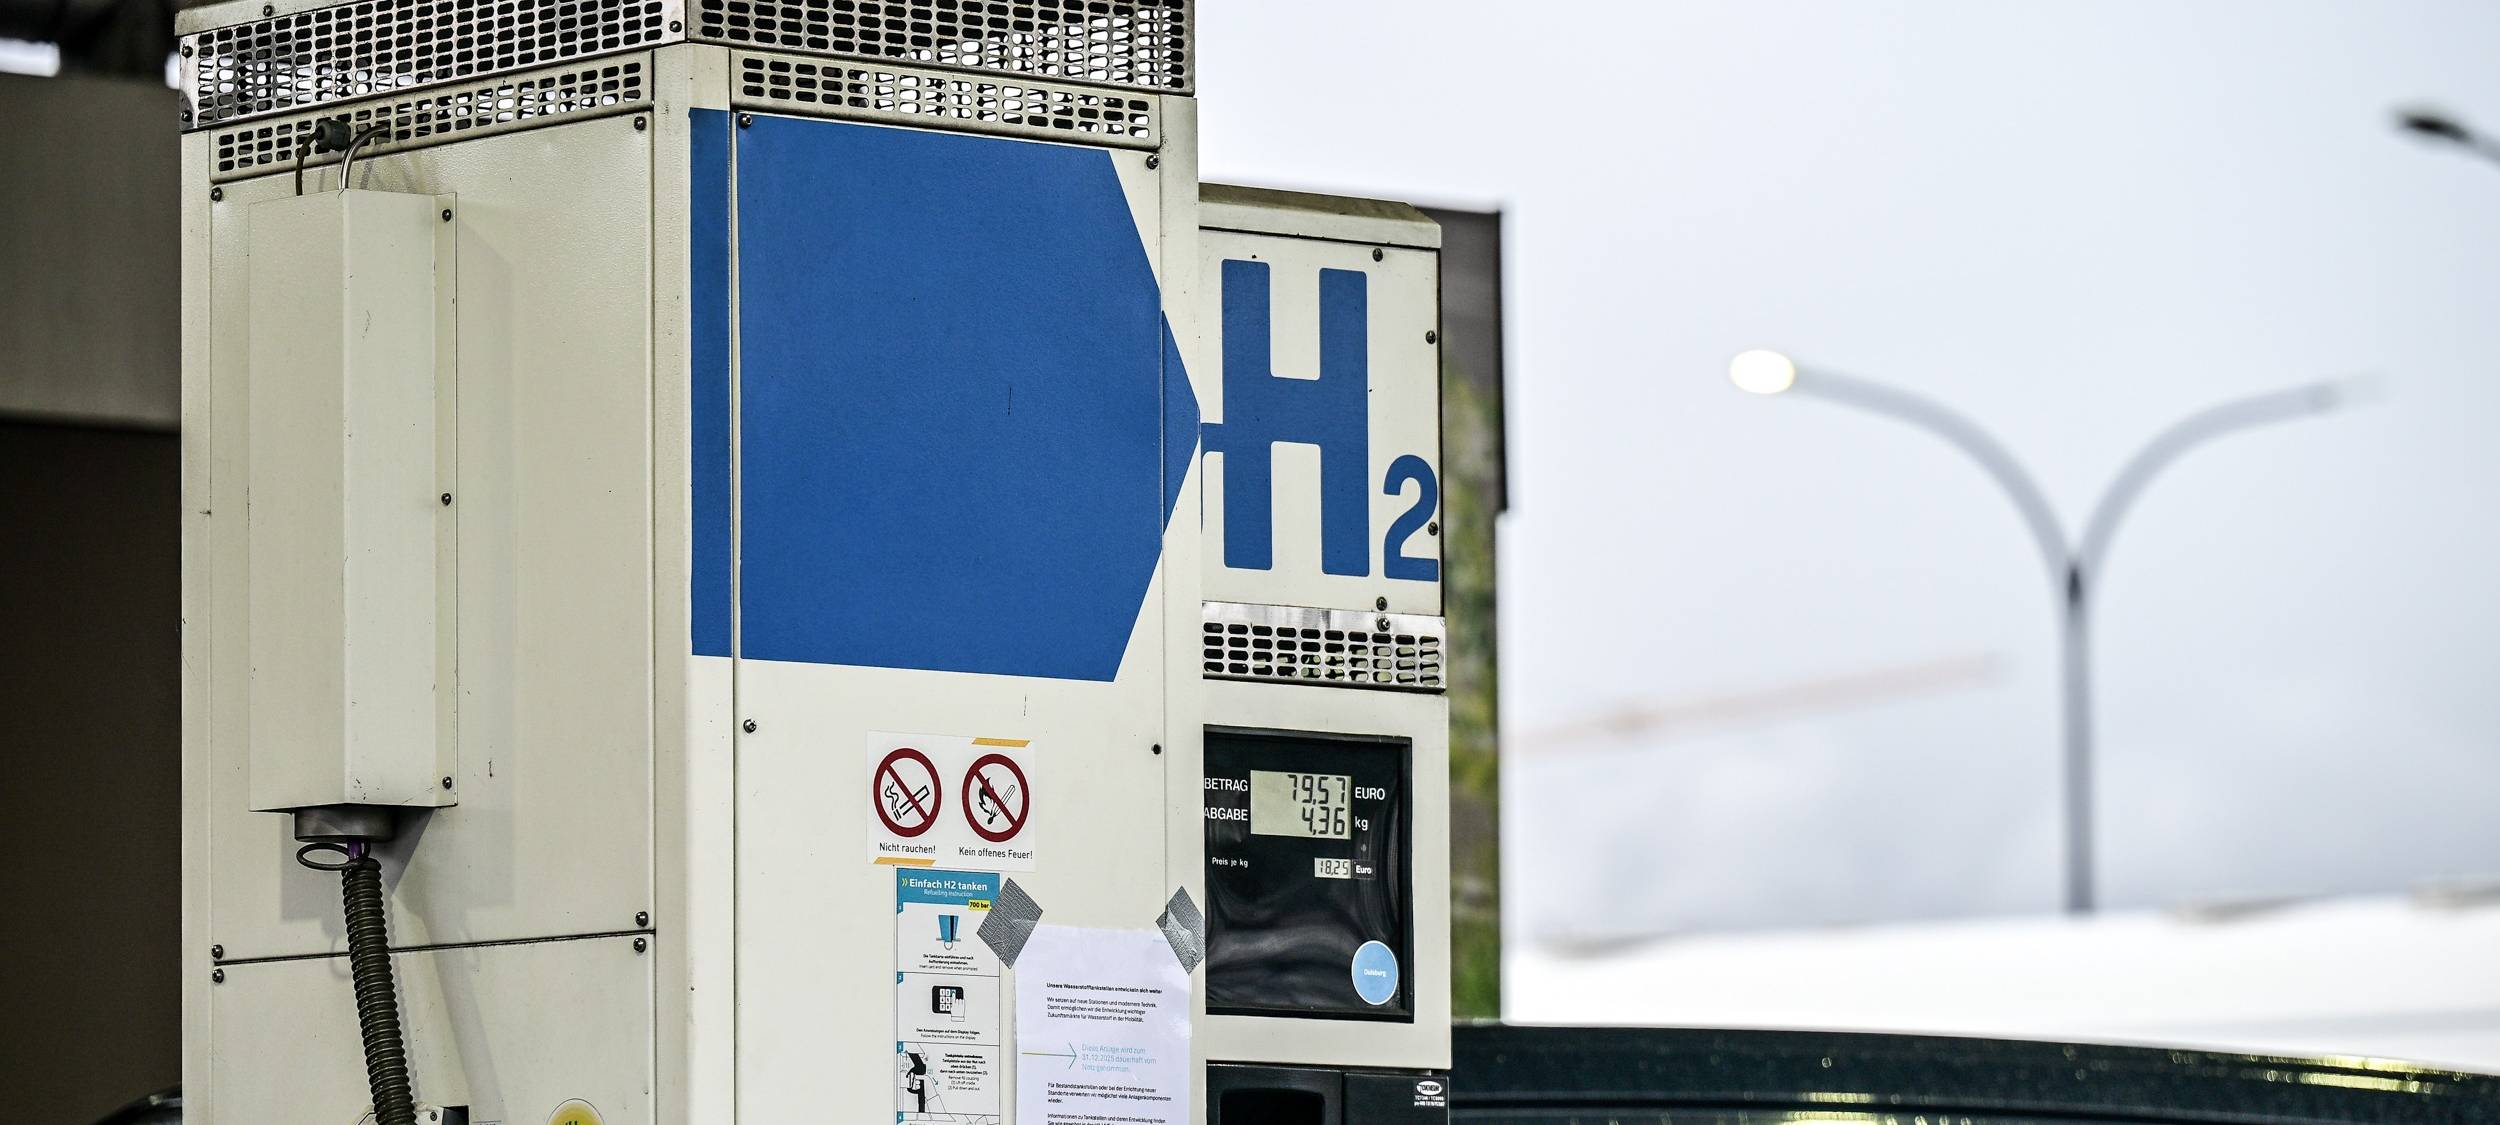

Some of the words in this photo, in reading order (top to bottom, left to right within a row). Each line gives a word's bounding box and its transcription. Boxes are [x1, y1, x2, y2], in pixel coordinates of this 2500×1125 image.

[1204, 777, 1248, 791] BETRAG
[1288, 774, 1346, 805] 79,57
[1355, 787, 1385, 800] EURO
[1204, 807, 1248, 821] ABGABE
[1302, 806, 1346, 835] 4,36
[1355, 816, 1368, 831] kg
[880, 842, 900, 852] Nicht
[902, 844, 936, 854] rauchen!
[959, 847, 976, 856] Kein
[978, 848, 1006, 858] offenes
[1008, 850, 1033, 860] Feuer!
[1212, 856, 1228, 866] Preis
[1231, 858, 1238, 867] je
[1240, 858, 1248, 868] kg
[1320, 860, 1349, 876] 18,25
[1356, 865, 1372, 874] Euro
[910, 879, 942, 889] Einfach
[944, 880, 956, 890] H2
[958, 881, 988, 891] tanken
